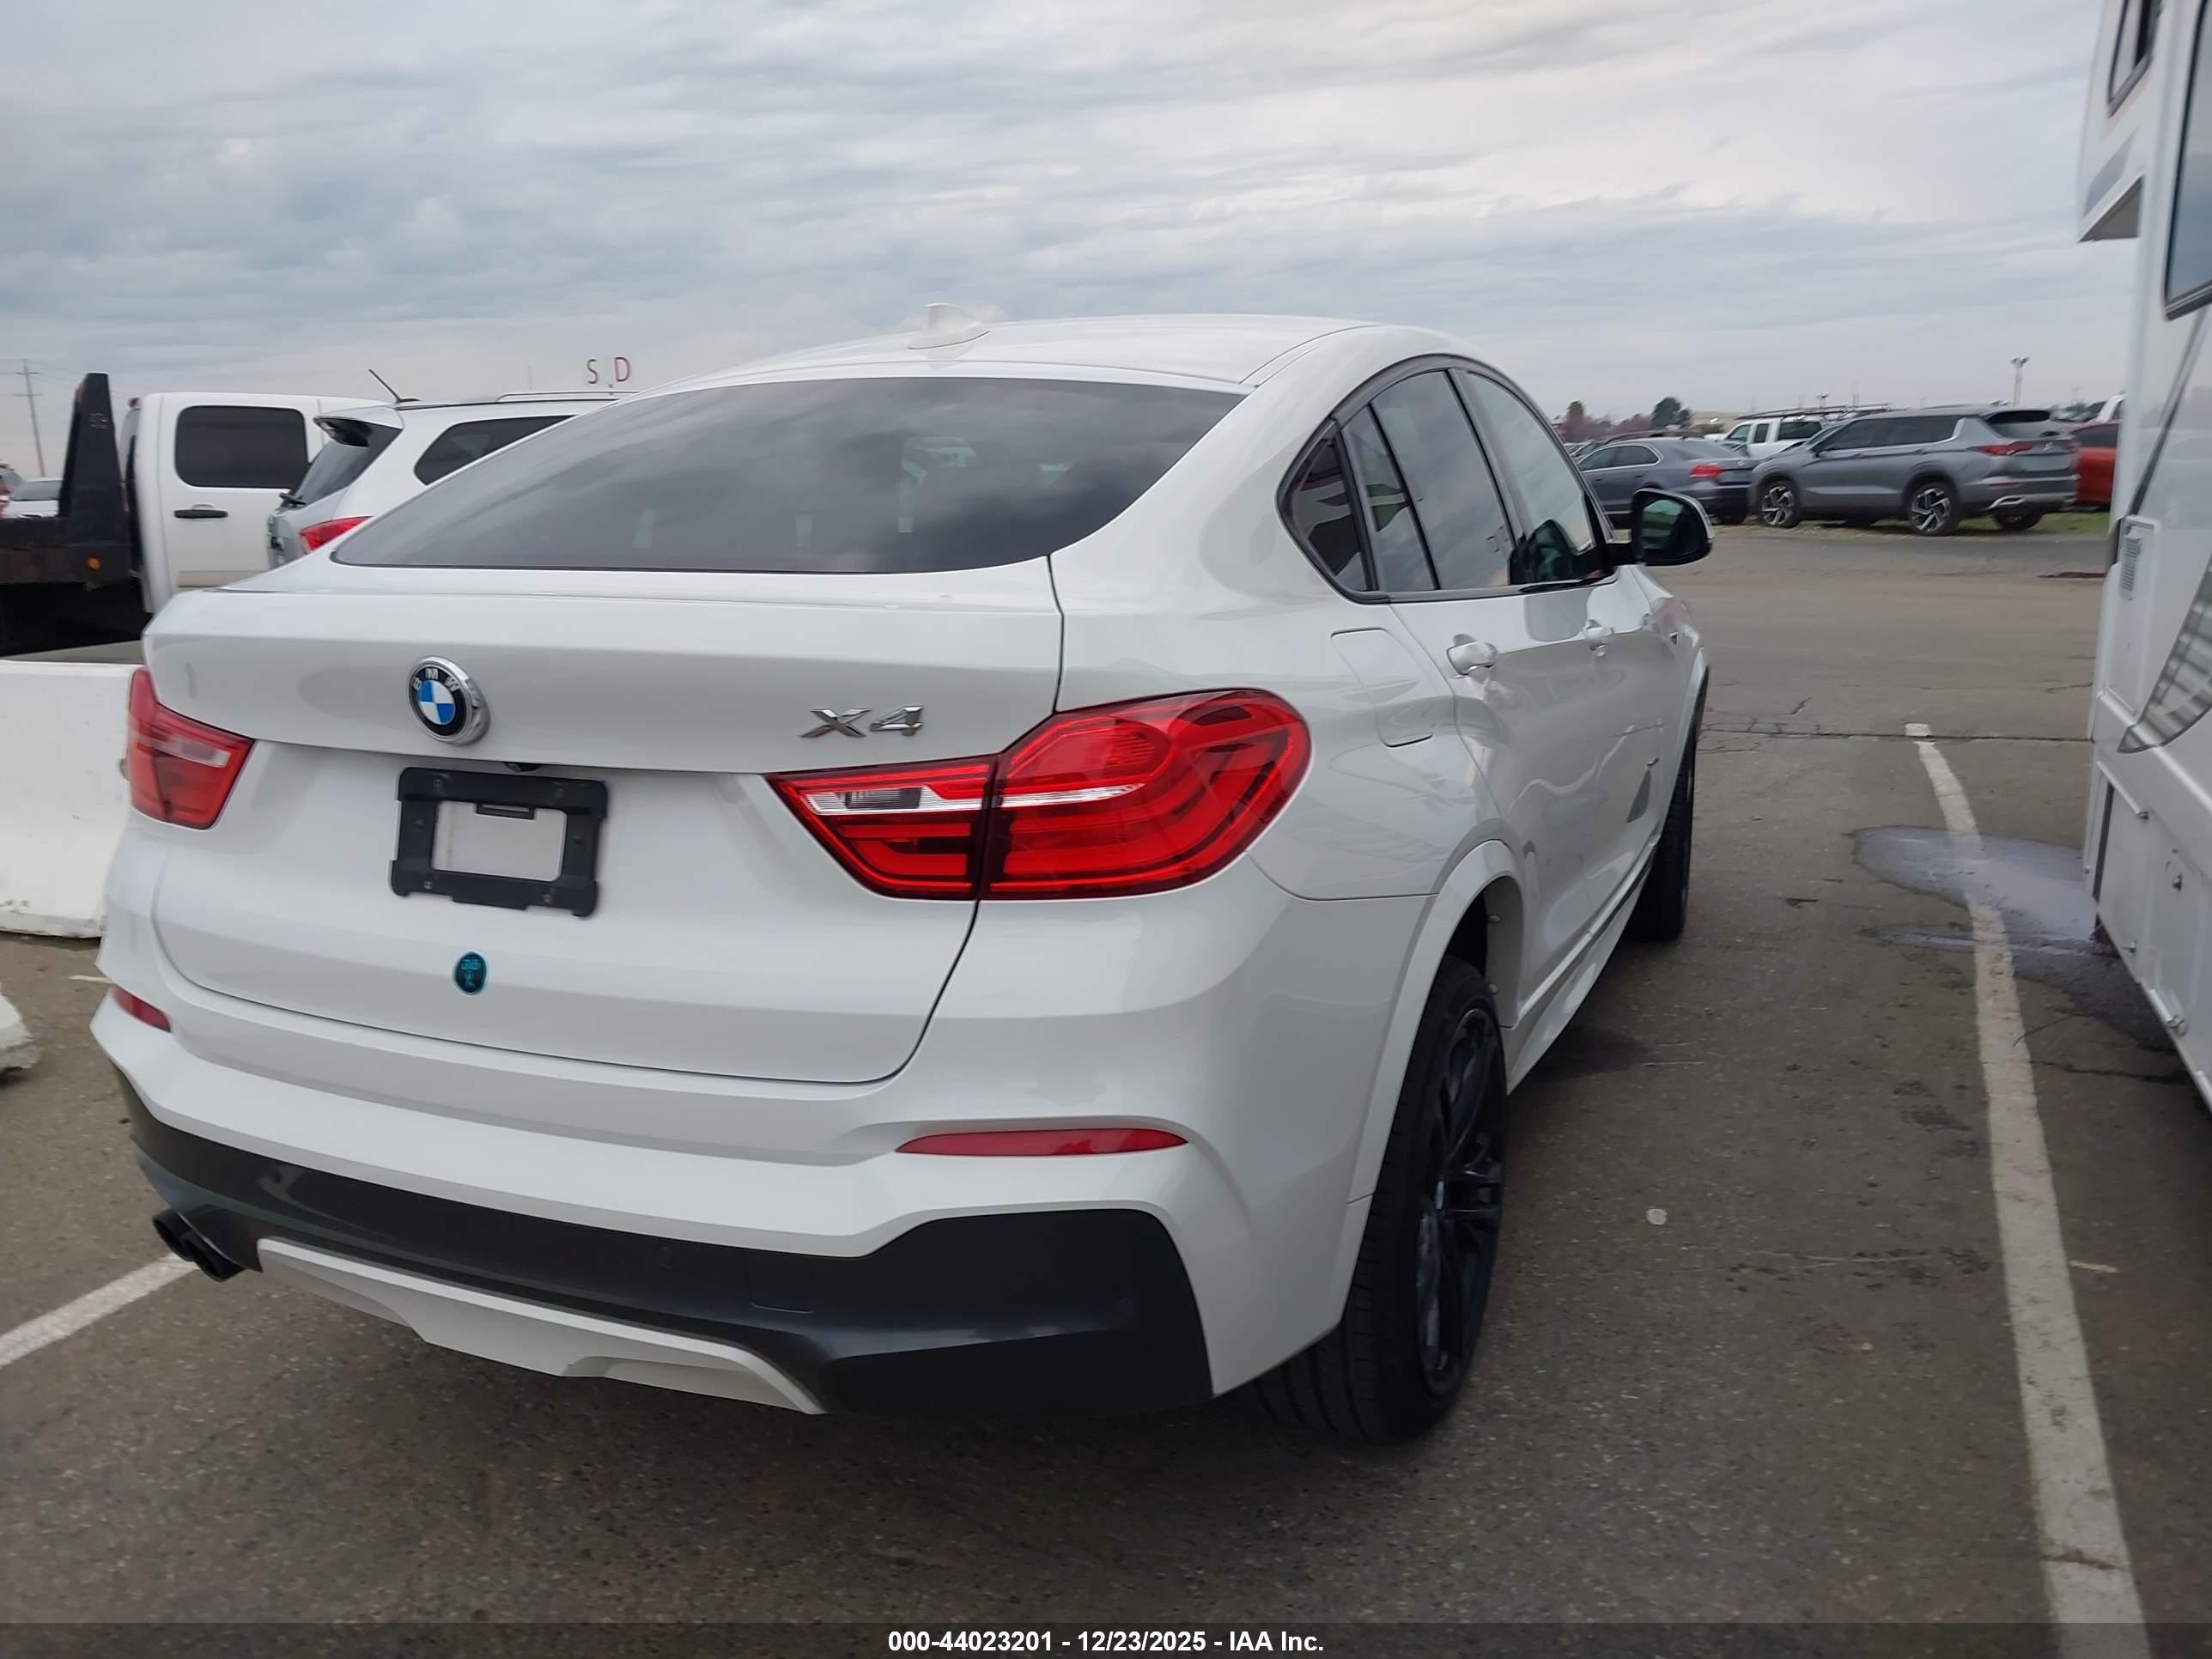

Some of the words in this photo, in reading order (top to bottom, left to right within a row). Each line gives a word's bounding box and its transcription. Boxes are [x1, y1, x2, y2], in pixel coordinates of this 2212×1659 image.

[586, 358, 599, 384] S
[614, 356, 630, 382] D
[411, 667, 460, 692] BMW
[799, 705, 924, 738] X4
